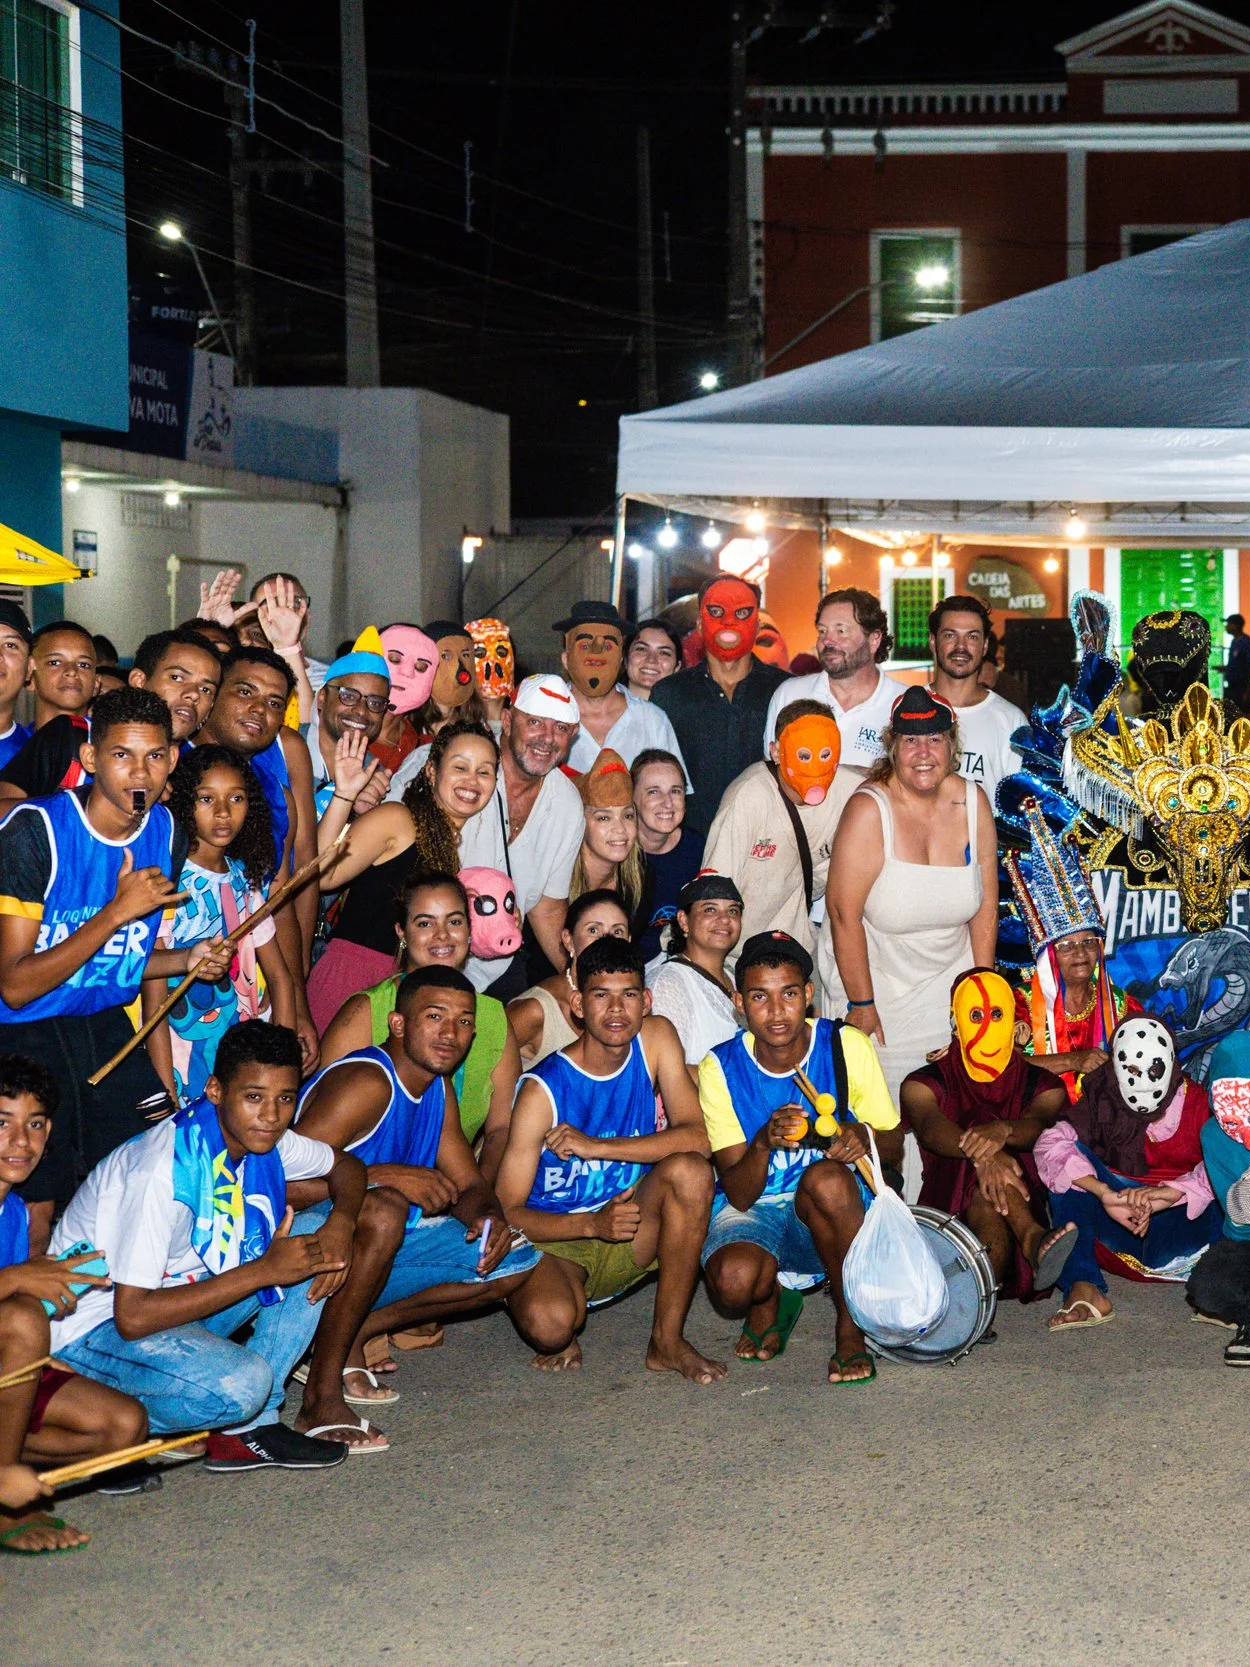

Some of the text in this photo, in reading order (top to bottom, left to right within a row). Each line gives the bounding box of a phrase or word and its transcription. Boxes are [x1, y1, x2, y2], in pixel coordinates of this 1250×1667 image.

[147, 399, 179, 427] MOTA
[967, 572, 1011, 586] CADEIA
[989, 585, 1011, 598] DAS
[1007, 593, 1046, 609] ARTES
[1089, 868, 1189, 955] MAMB
